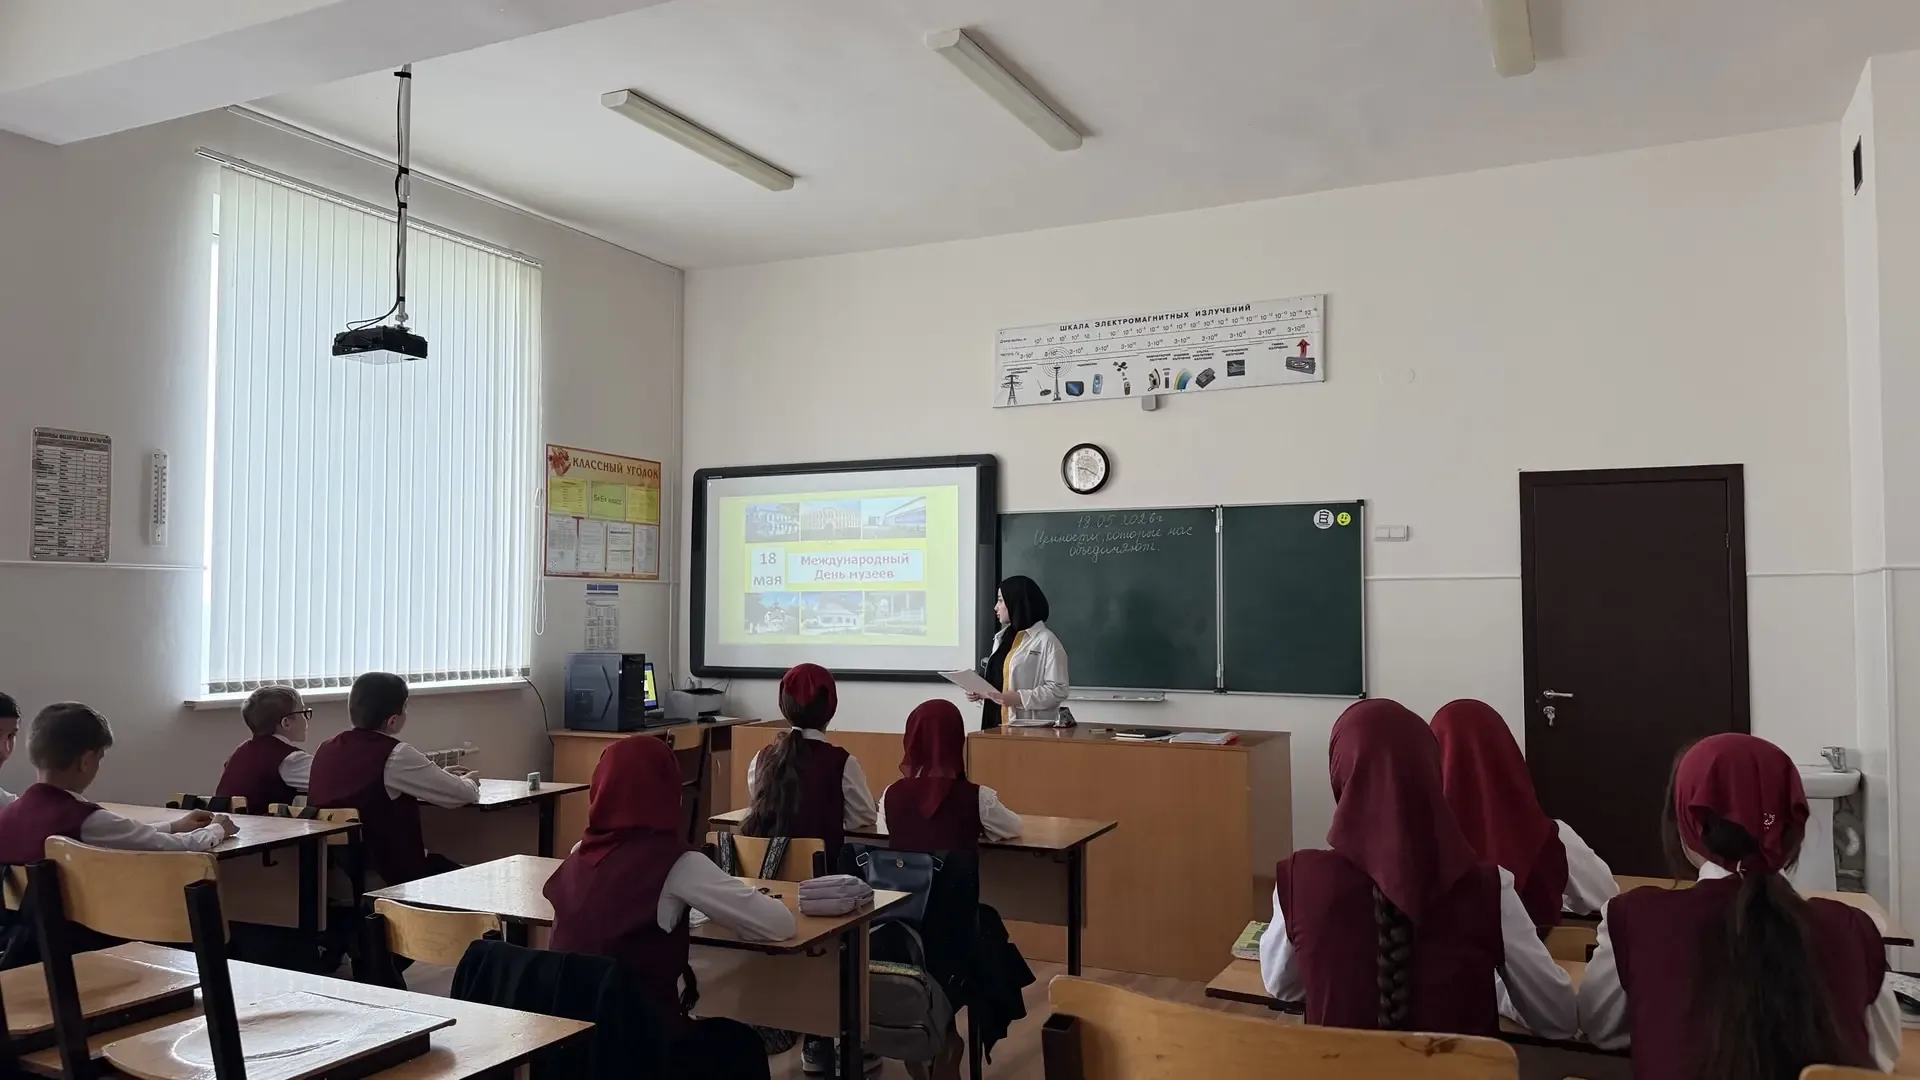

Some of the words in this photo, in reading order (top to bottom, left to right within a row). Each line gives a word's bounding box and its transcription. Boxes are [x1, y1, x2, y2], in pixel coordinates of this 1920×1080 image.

[1059, 323, 1090, 331] ШКАЛА
[1095, 312, 1189, 327] ЭЛЕКТРОМАГНИТНЫХ
[1195, 304, 1251, 316] ИЗЛУЧЕНИЙ
[572, 457, 623, 473] КЛАССНЫЙ
[626, 465, 659, 479] УГОЛОК
[759, 553, 777, 565] 18
[800, 553, 910, 567] Международный
[753, 574, 783, 586] мая
[813, 569, 846, 581] День
[848, 567, 895, 581] музеев
